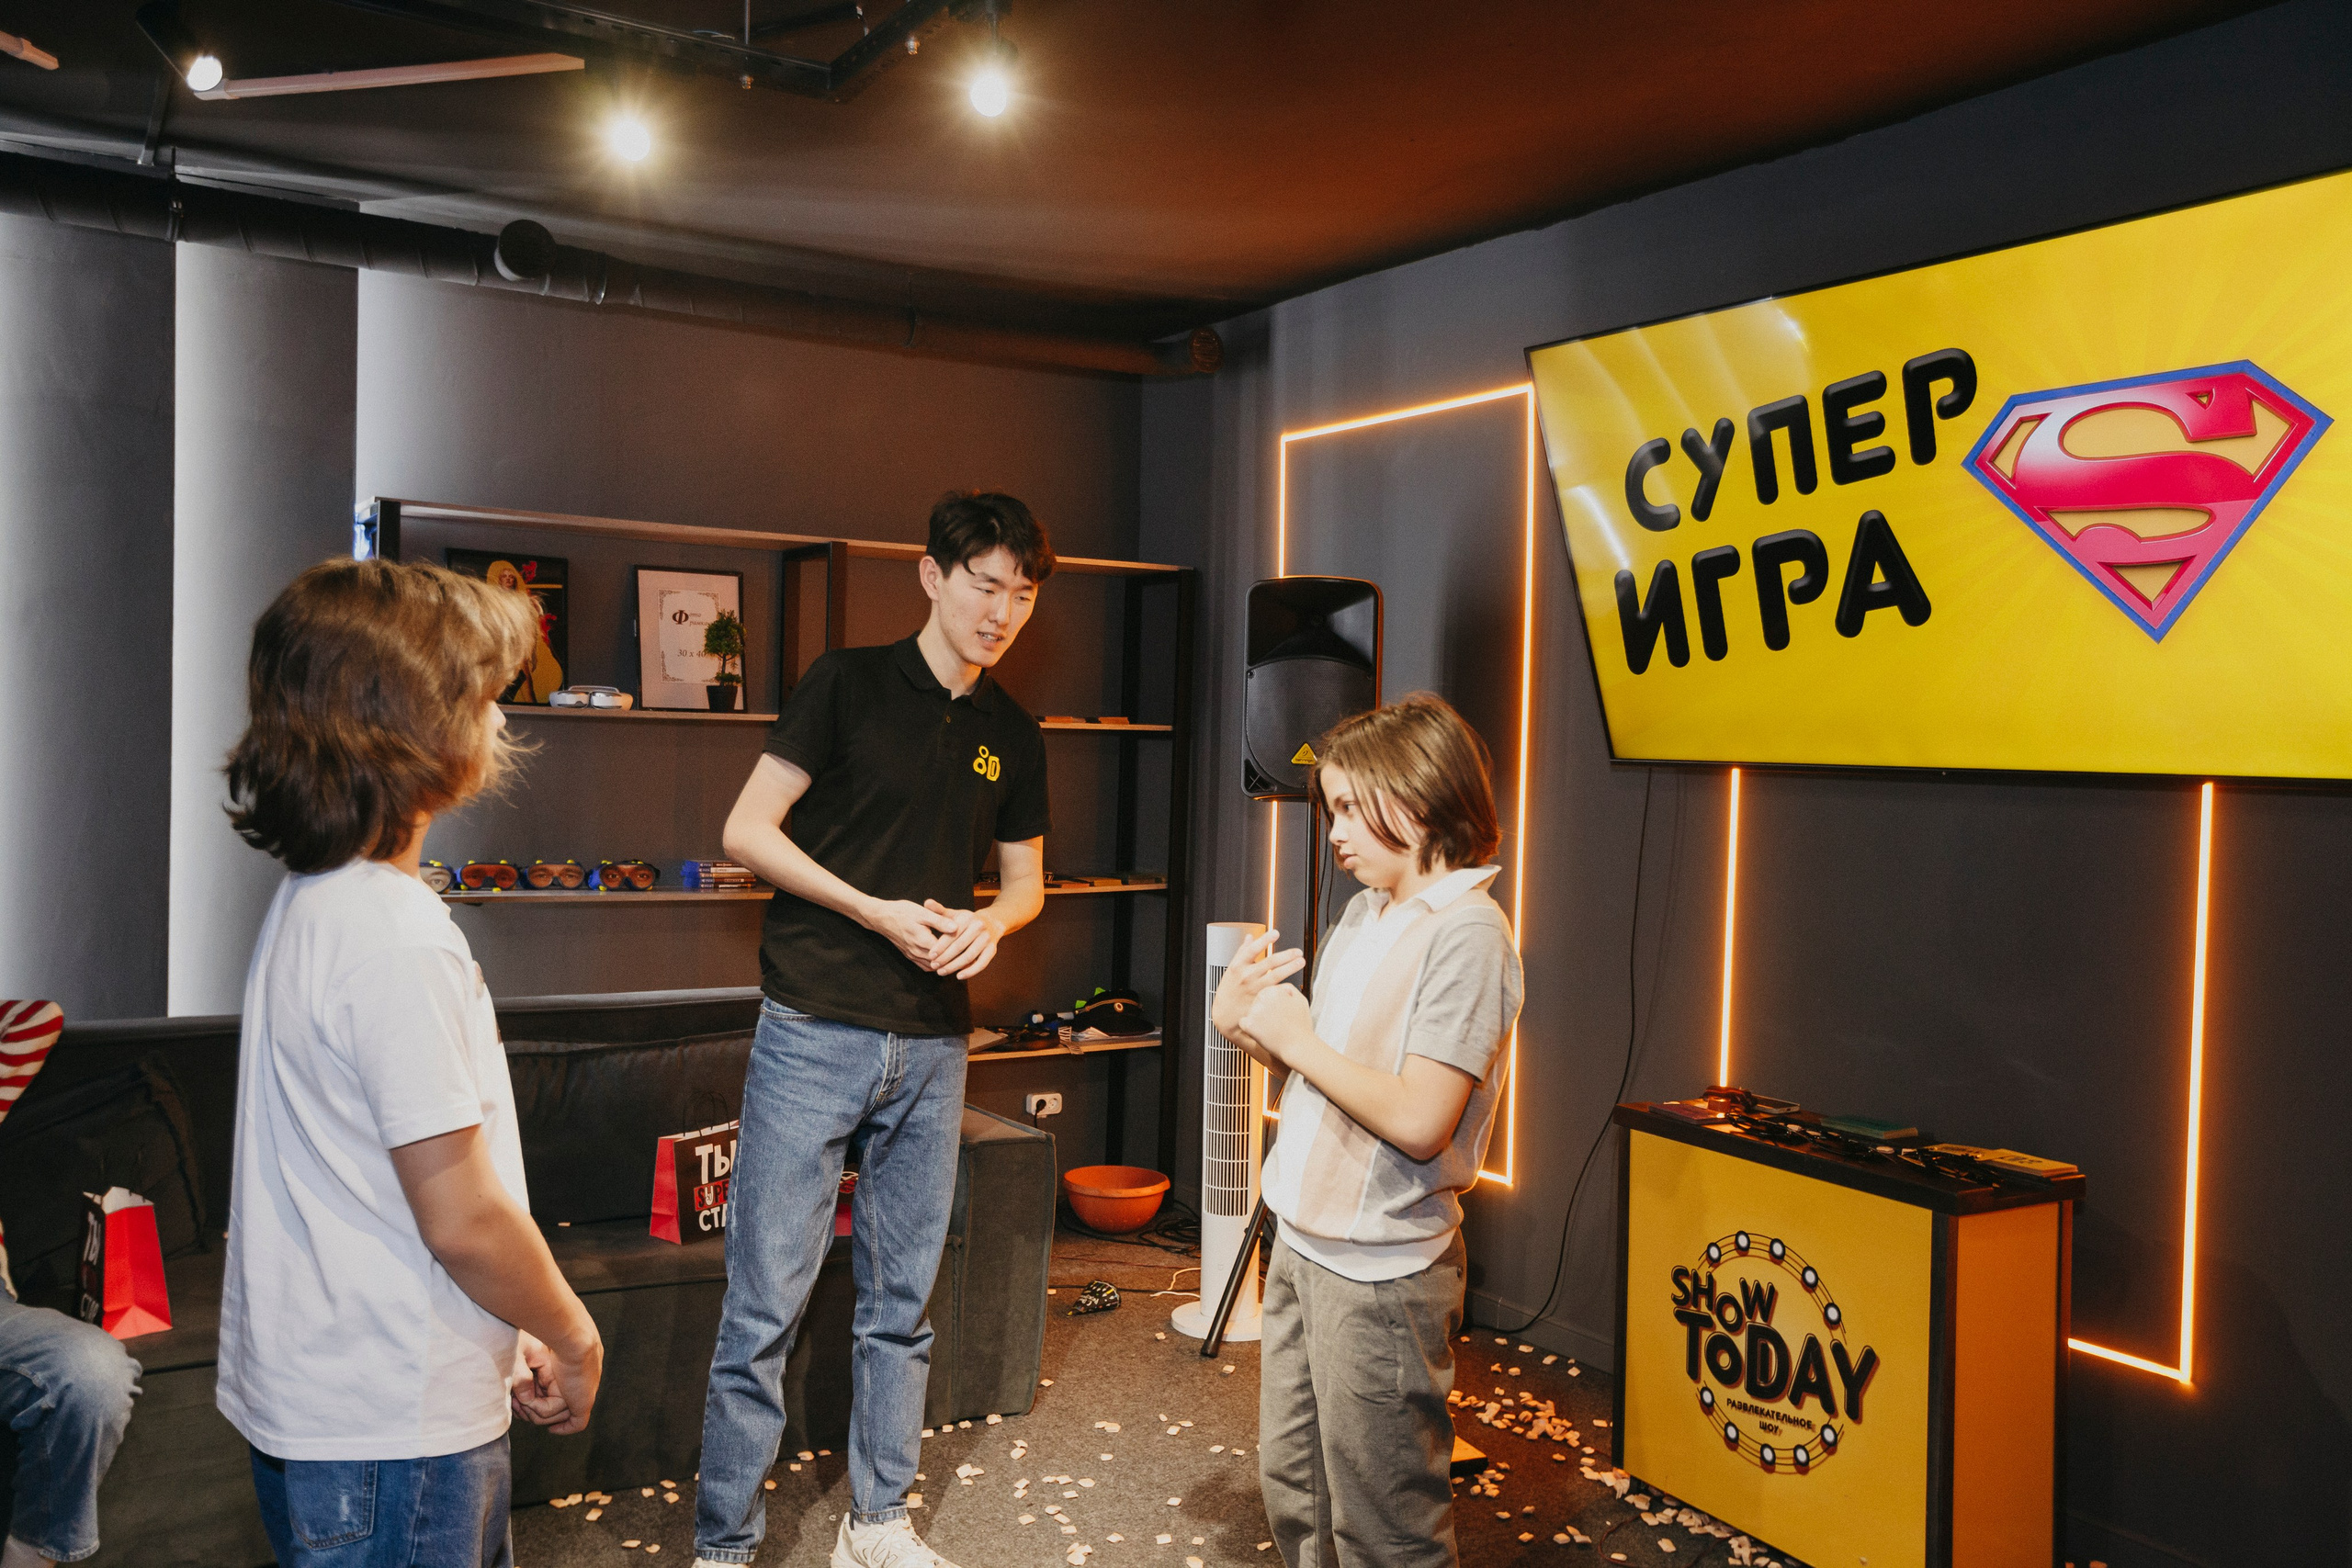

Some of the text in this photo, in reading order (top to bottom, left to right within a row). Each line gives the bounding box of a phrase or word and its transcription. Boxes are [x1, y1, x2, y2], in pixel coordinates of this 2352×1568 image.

[1624, 347, 1978, 532] СУПЕР
[1613, 509, 1932, 675] ИГРА
[677, 649, 688, 658] 30
[696, 649, 707, 658] 40
[697, 1179, 729, 1208] SUPE
[1671, 1265, 1779, 1335] SHOW
[1672, 1306, 1879, 1422] TODAY
[1726, 1397, 1813, 1429] РАЗВЛЕКАТЕЛЬНОЕ
[1758, 1420, 1780, 1435] ШОУ
